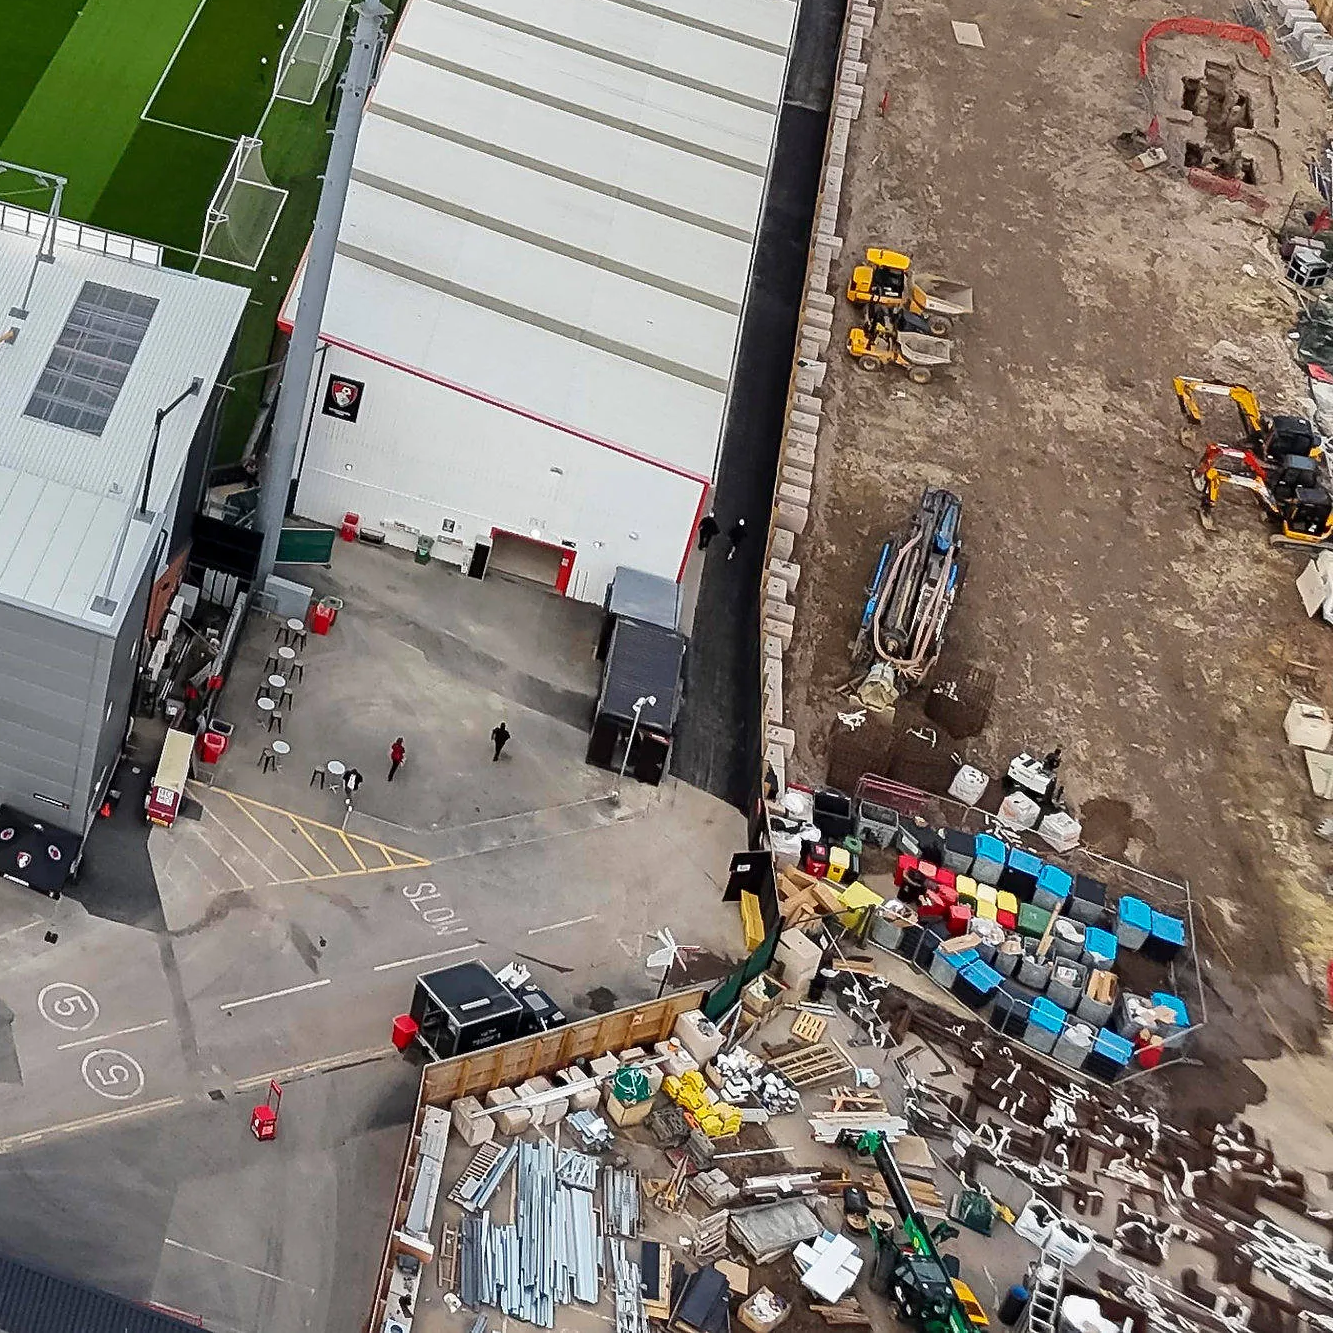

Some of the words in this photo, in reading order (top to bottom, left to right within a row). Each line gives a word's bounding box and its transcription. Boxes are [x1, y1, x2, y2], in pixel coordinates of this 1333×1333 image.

[401, 881, 470, 936] SLOW
[54, 995, 89, 1017] 5
[95, 1065, 129, 1087] 5
